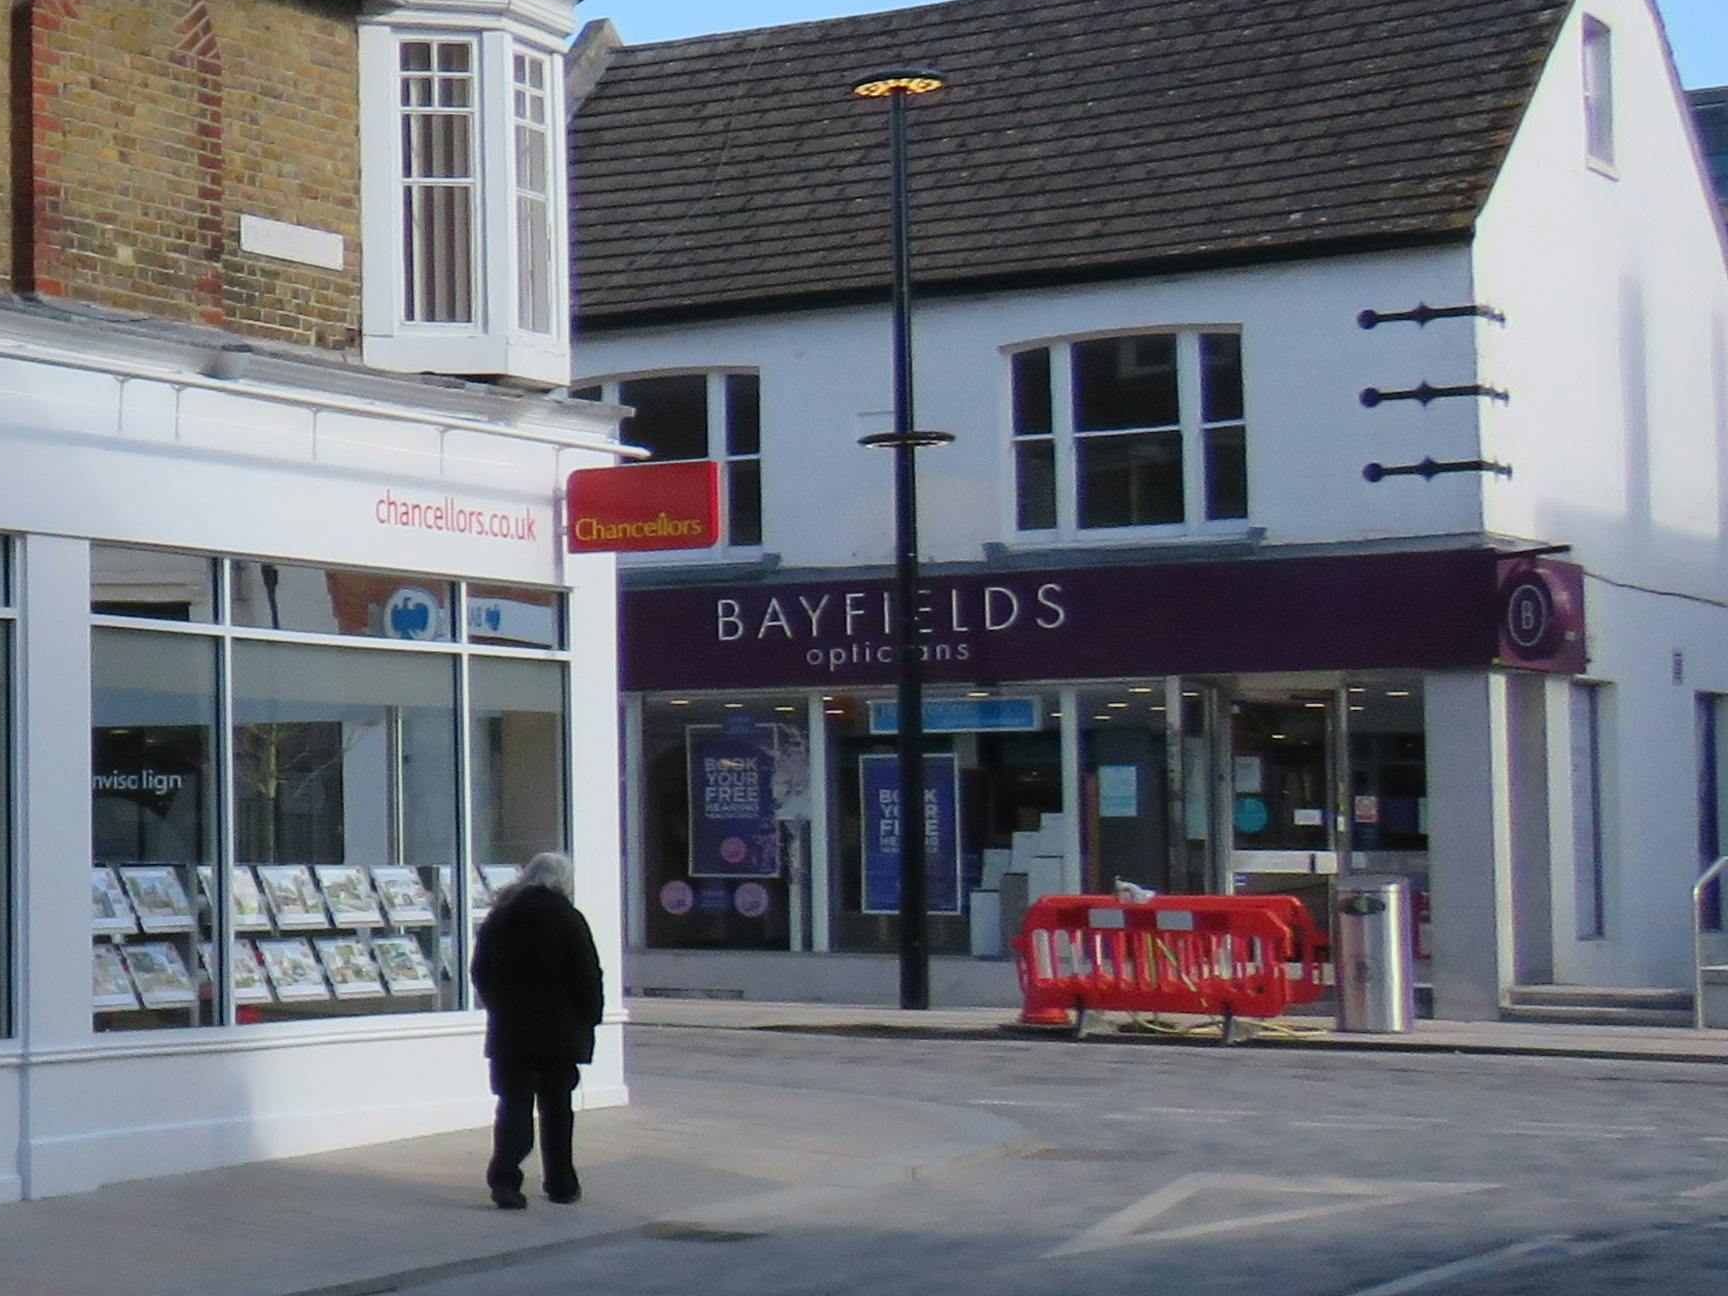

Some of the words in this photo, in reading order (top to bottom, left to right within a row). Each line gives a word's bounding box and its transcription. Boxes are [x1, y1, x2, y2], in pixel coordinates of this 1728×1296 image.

[375, 490, 537, 542] chancellors.co.uk
[575, 512, 703, 542] Chancellors
[806, 640, 970, 672] opticans
[706, 771, 759, 786] YOUR
[705, 786, 760, 802] FREE
